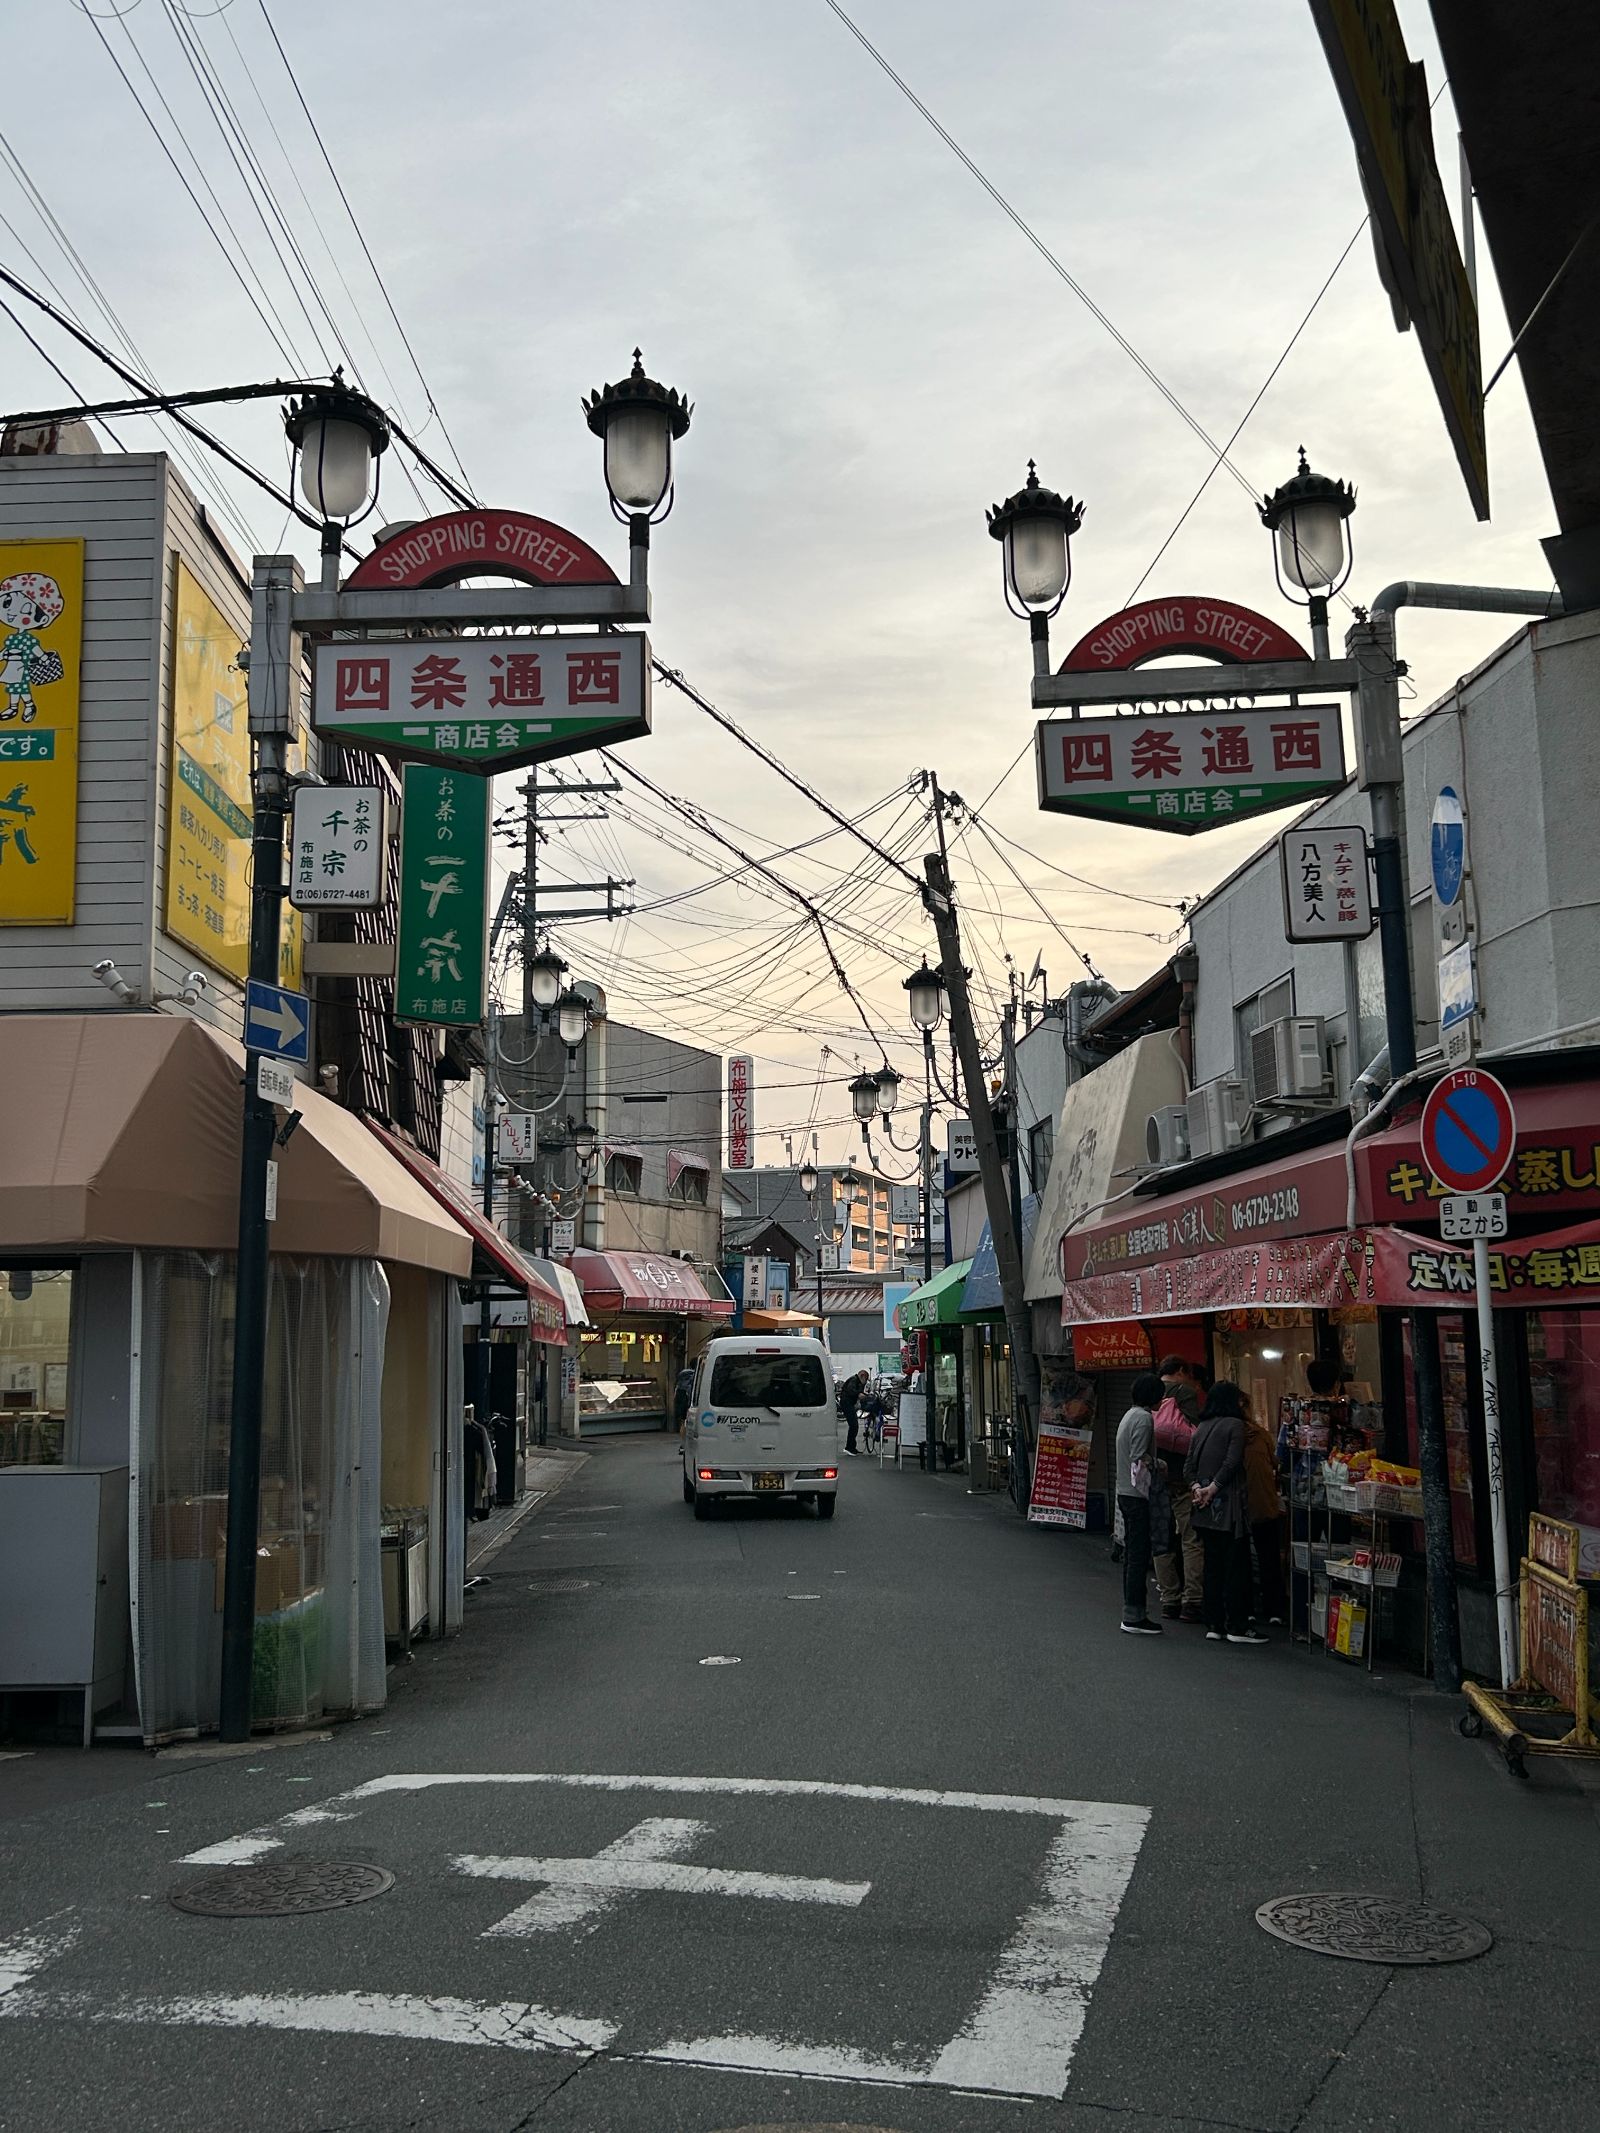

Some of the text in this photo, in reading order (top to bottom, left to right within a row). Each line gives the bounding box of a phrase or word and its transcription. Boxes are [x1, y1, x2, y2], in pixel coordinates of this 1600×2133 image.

[380, 521, 580, 582] SHOPPING STREET
[1091, 607, 1272, 665] SHOPPING STREET
[335, 652, 621, 712] 四条通西
[434, 723, 520, 750] 商店会
[1062, 722, 1322, 784] 四条通西
[352, 799, 372, 852] お茶の
[434, 776, 458, 841] お茶の
[1155, 789, 1234, 815] 商店会
[299, 841, 314, 883] 布施店
[321, 810, 350, 877] 千宗
[1301, 844, 1325, 922] 八方美人
[1333, 842, 1358, 922] キムチ・蒸し豚
[411, 997, 467, 1015] 布施店
[1450, 1071, 1477, 1089] 1-10
[502, 1118, 524, 1156] 大山どり
[731, 1059, 747, 1168] 布施文化教室
[954, 1135, 975, 1145] 美容
[1232, 1187, 1299, 1230] 06-6729-2348
[1443, 1197, 1503, 1216] 自動車
[1443, 1215, 1504, 1237] ここから
